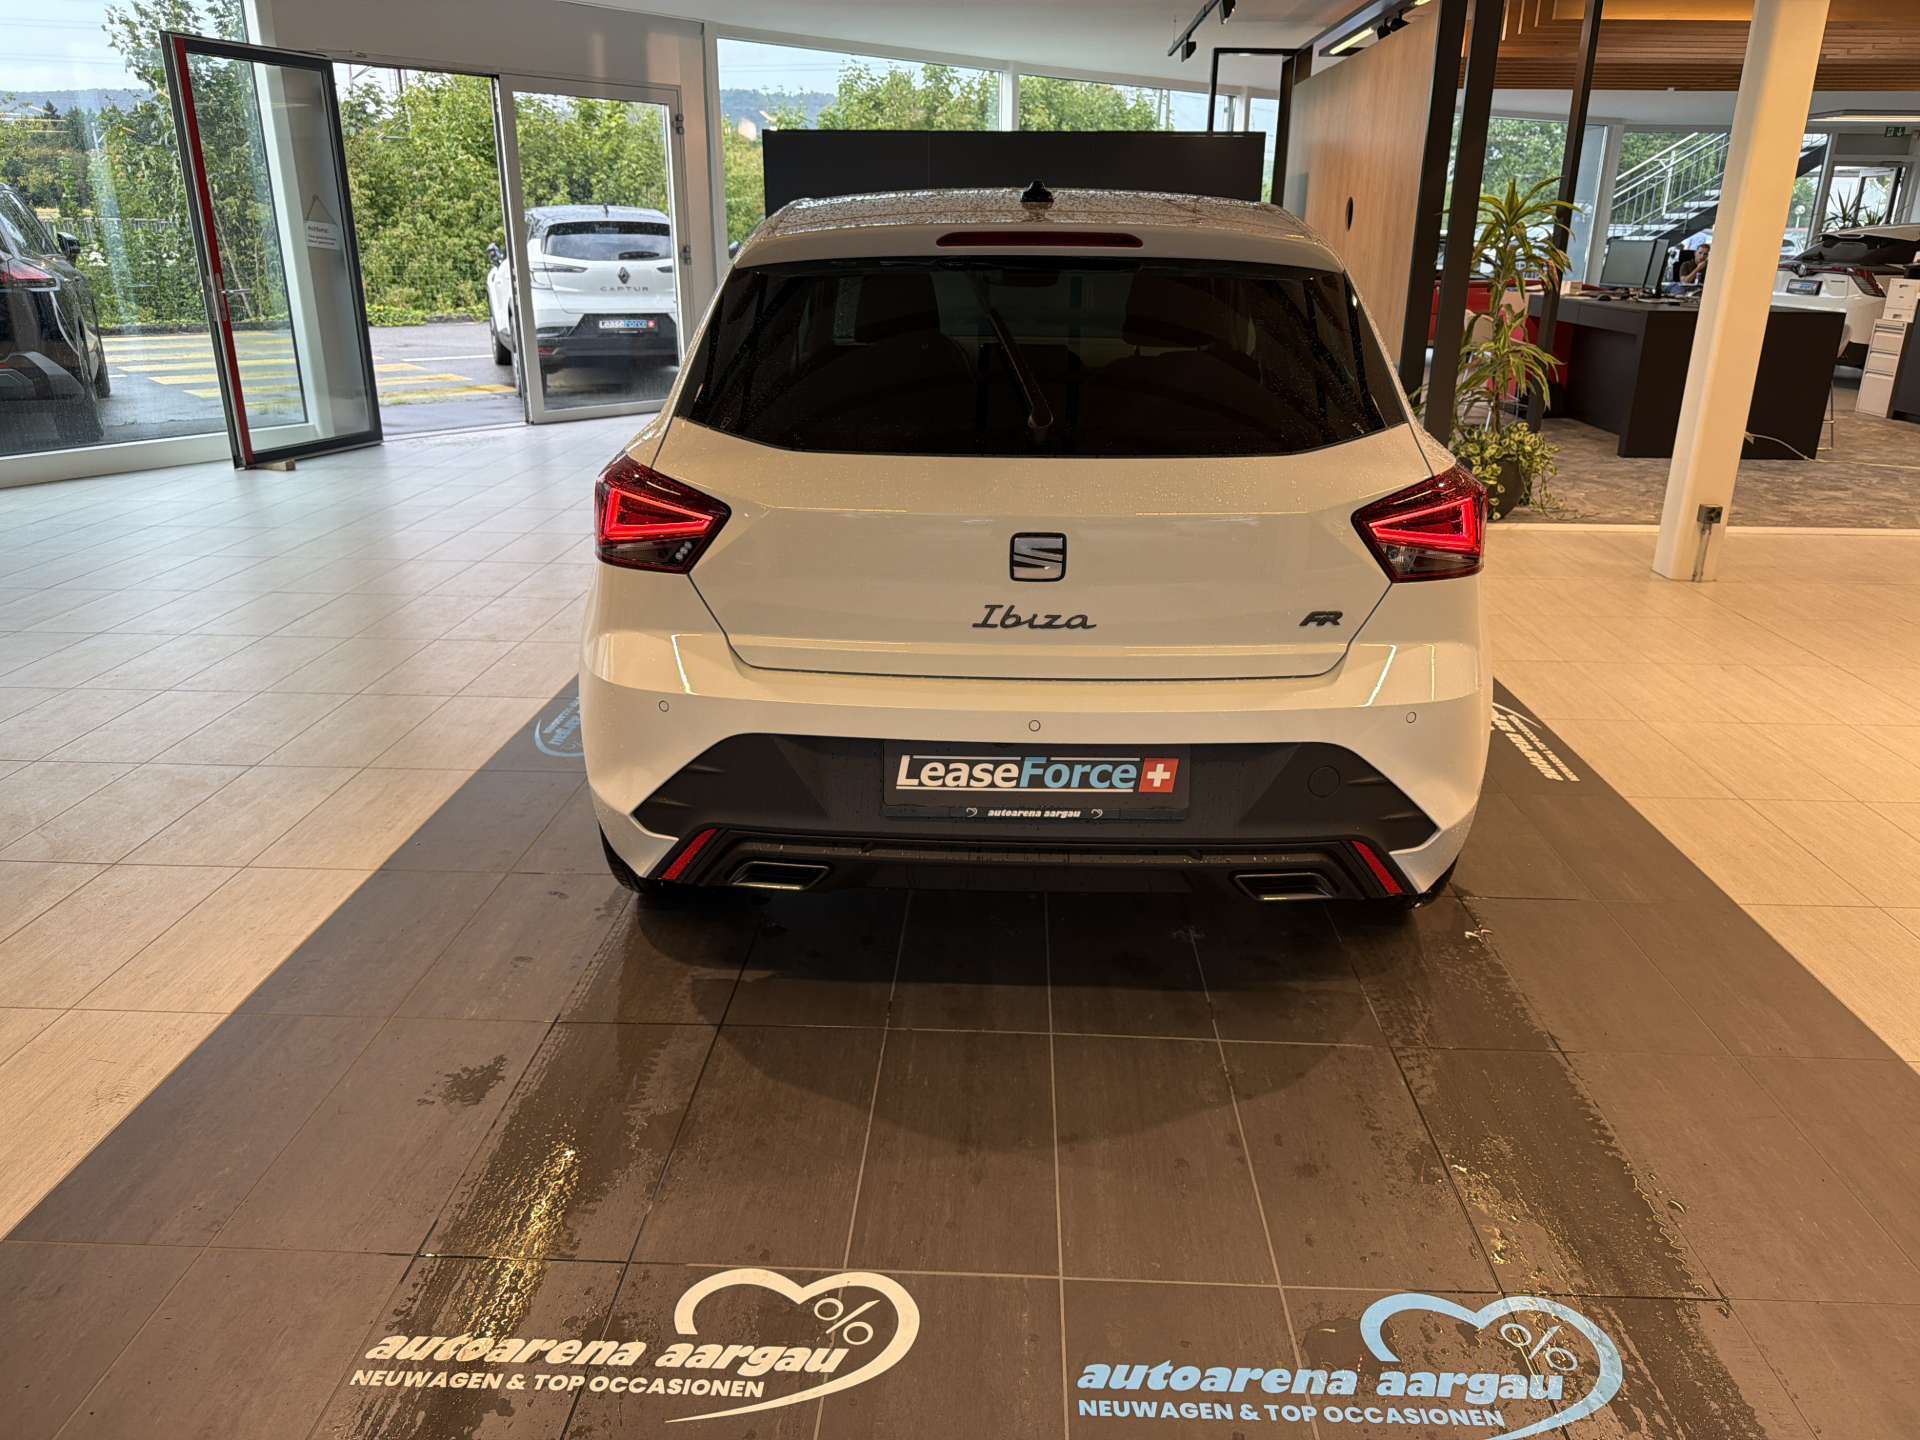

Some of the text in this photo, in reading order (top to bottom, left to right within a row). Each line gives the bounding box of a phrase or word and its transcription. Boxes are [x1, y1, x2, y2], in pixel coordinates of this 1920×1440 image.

[972, 605, 1096, 630] Ibiza
[1299, 610, 1343, 627] FR
[896, 755, 1137, 788] LeaseForce
[988, 808, 1082, 819] autoarena aargau
[366, 1333, 850, 1377] autoarena aargau
[350, 1368, 765, 1399] NEUWAGEN & TOP OCCASIONEN
[1077, 1360, 1563, 1405] autoarena aargau
[1078, 1399, 1506, 1428] NEUWAGEN & TOP OCCASIONEN
